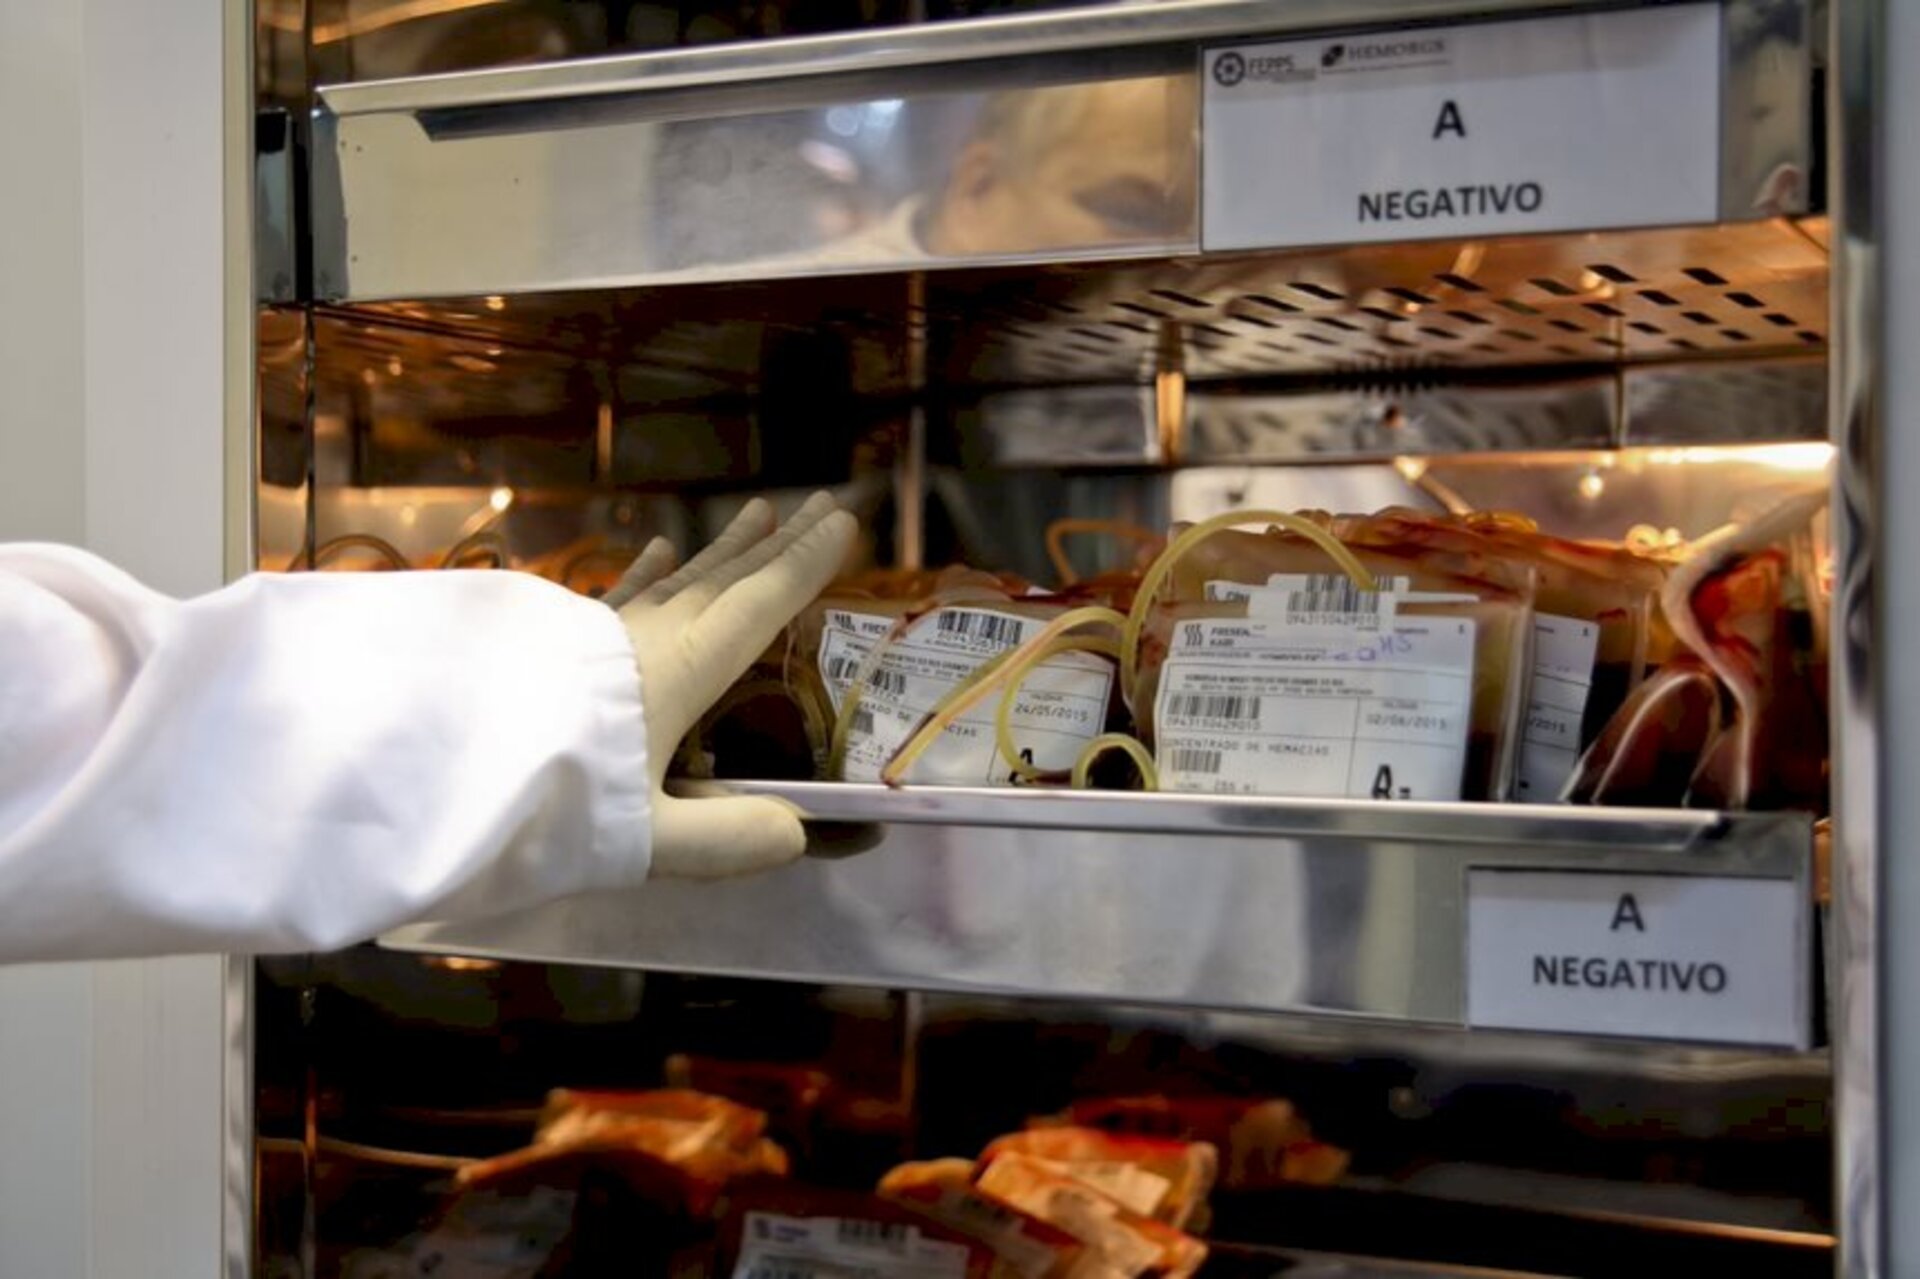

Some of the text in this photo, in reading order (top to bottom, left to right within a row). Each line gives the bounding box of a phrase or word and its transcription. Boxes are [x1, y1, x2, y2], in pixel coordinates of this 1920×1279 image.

[1432, 100, 1467, 140] A
[1357, 181, 1544, 223] NEGATIVO
[1610, 893, 1645, 932] A
[1533, 955, 1726, 993] NEGATIVO
